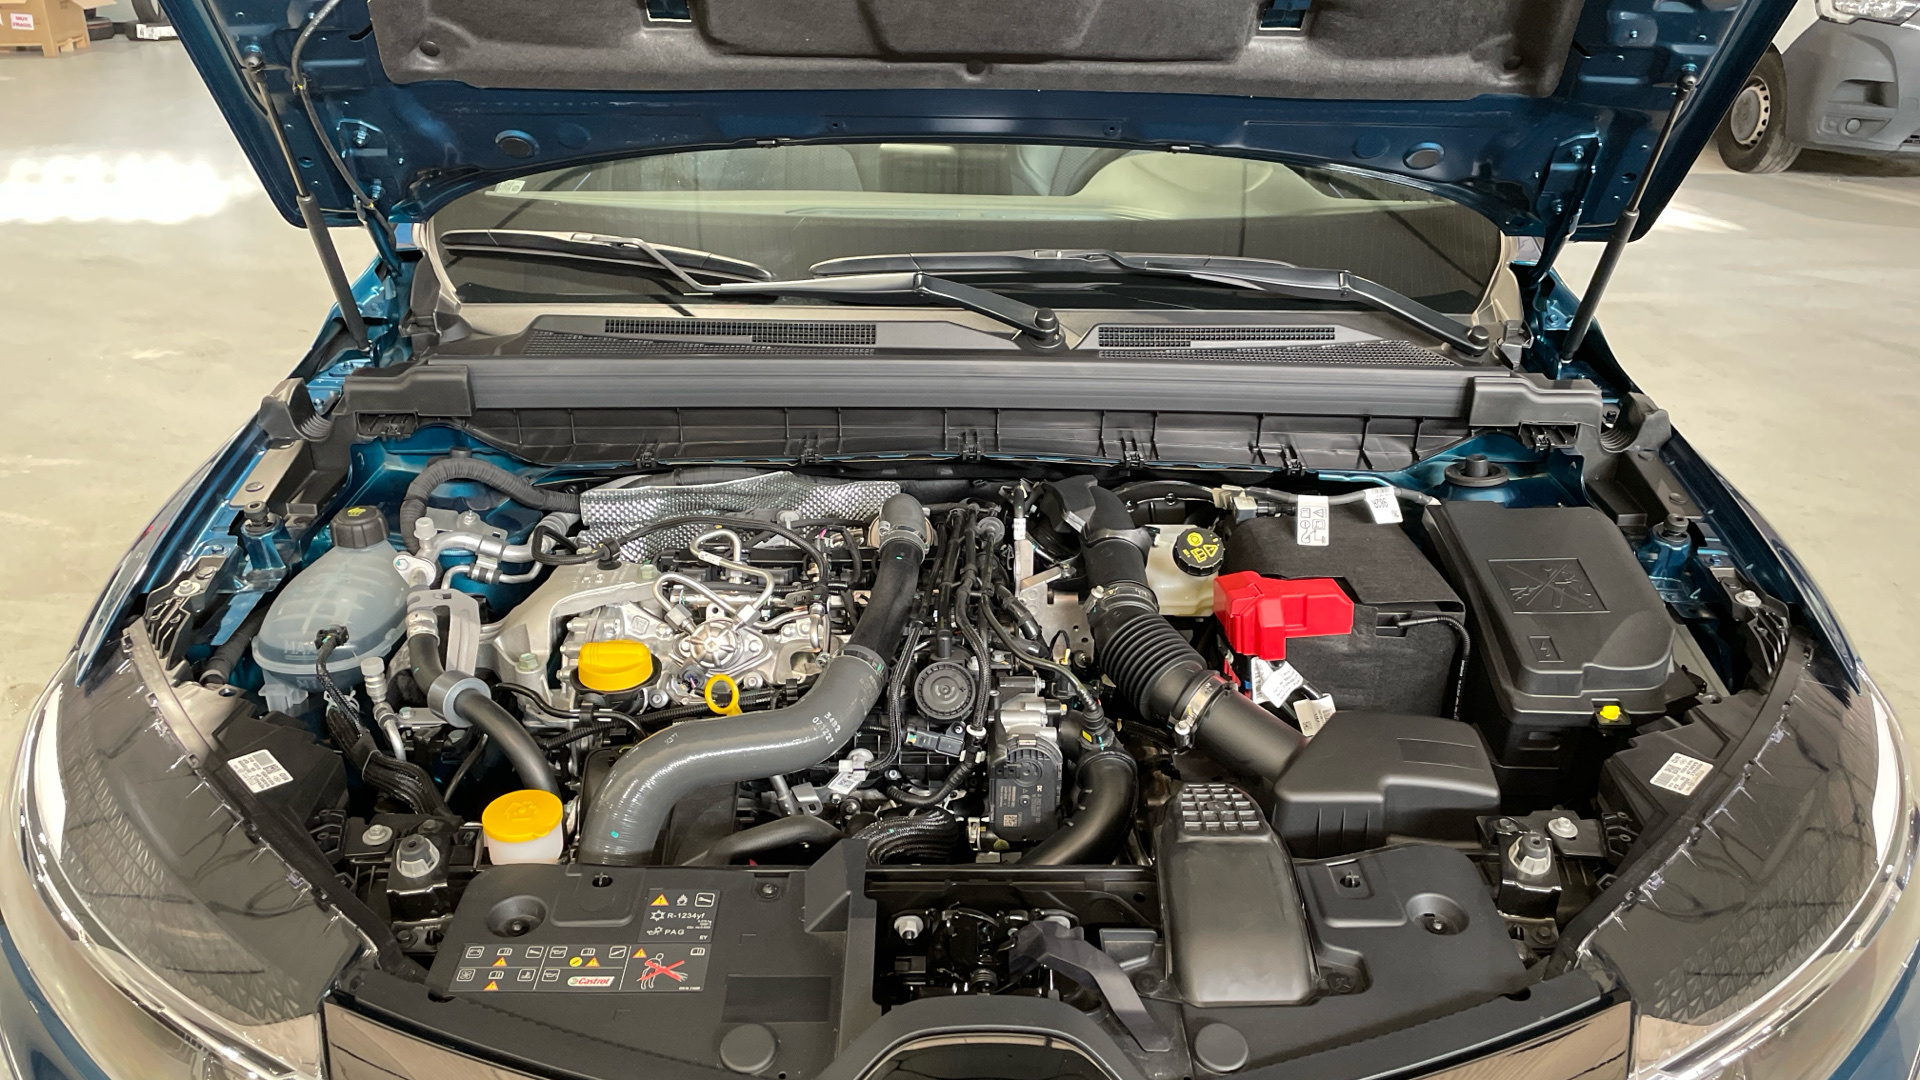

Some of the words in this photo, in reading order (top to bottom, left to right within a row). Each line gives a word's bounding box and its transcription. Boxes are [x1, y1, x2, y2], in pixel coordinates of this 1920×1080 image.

[666, 912, 706, 920] R-1234yf
[664, 928, 685, 936] PAG
[578, 977, 611, 985] Castrol
